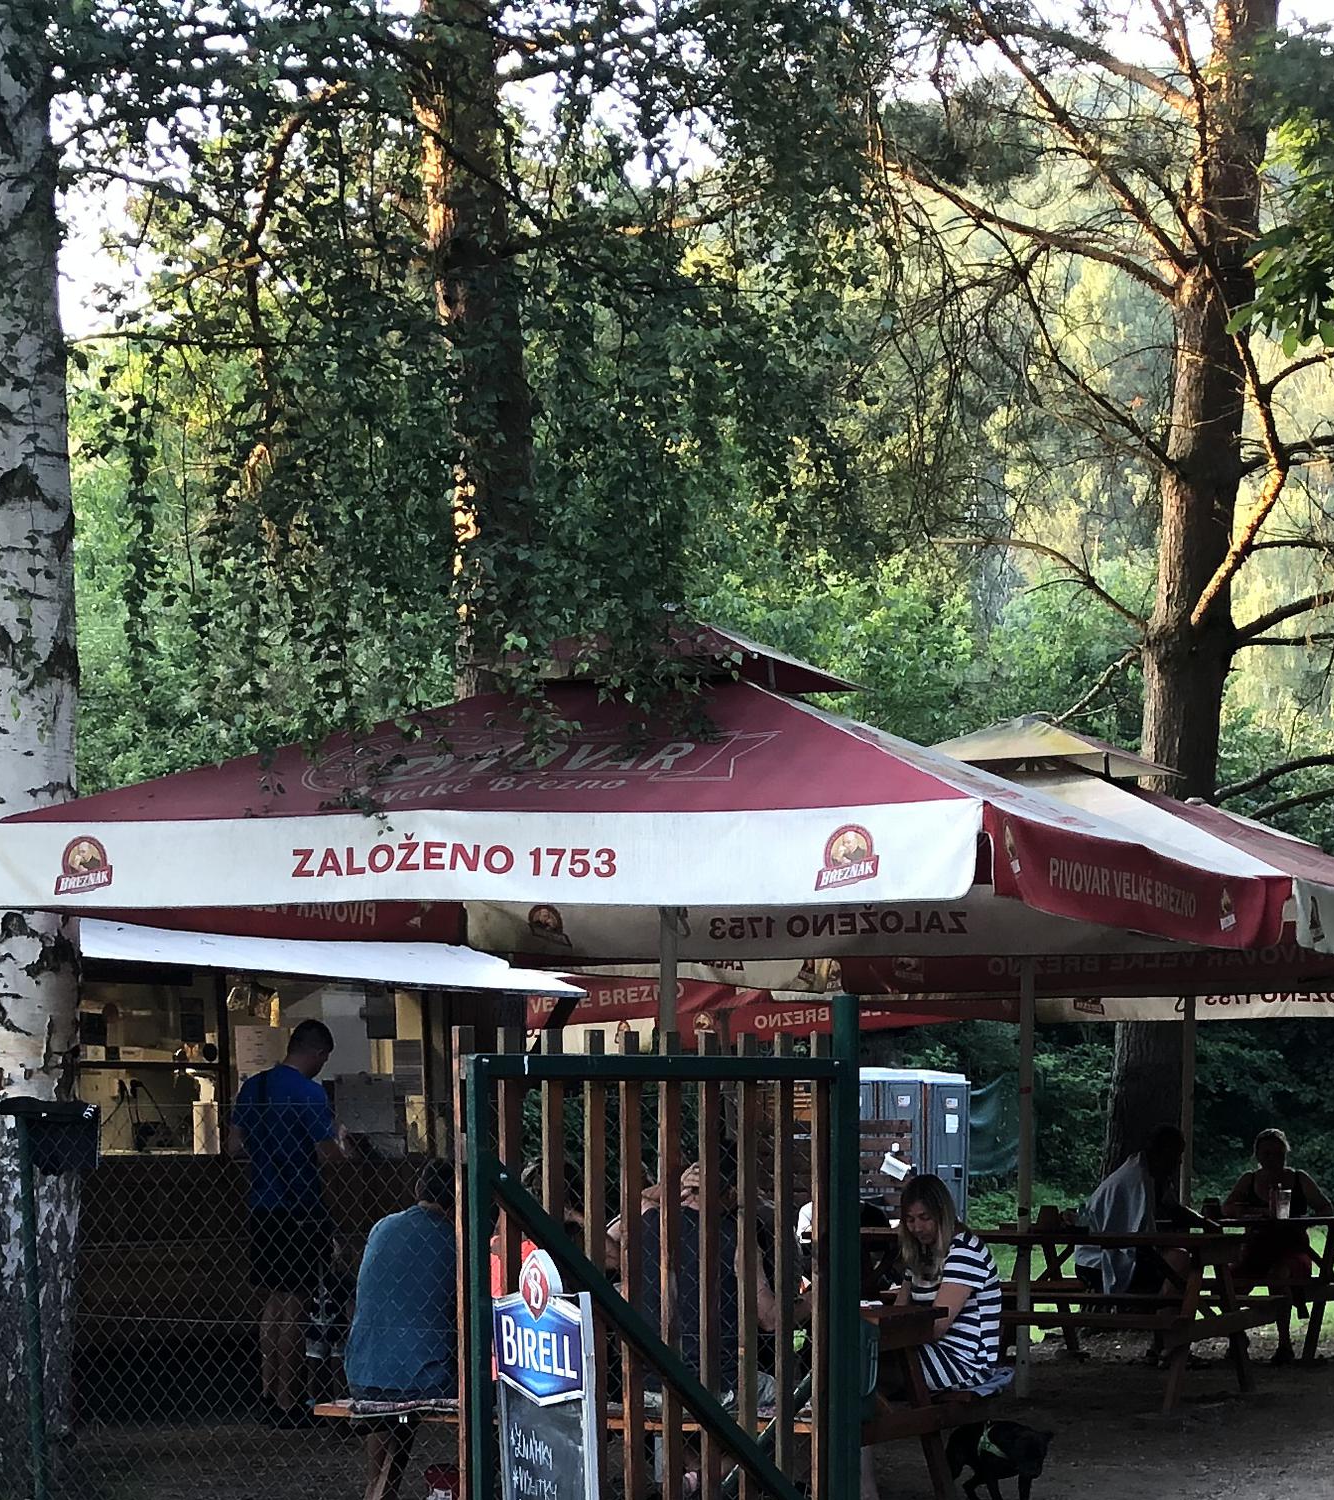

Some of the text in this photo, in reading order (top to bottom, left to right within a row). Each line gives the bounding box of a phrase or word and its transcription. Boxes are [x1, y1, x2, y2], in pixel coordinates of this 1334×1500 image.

[292, 832, 617, 878] ZALOŽENO 1753
[1050, 857, 1110, 897] PIVOVAR
[501, 1314, 578, 1380] BIRELL
